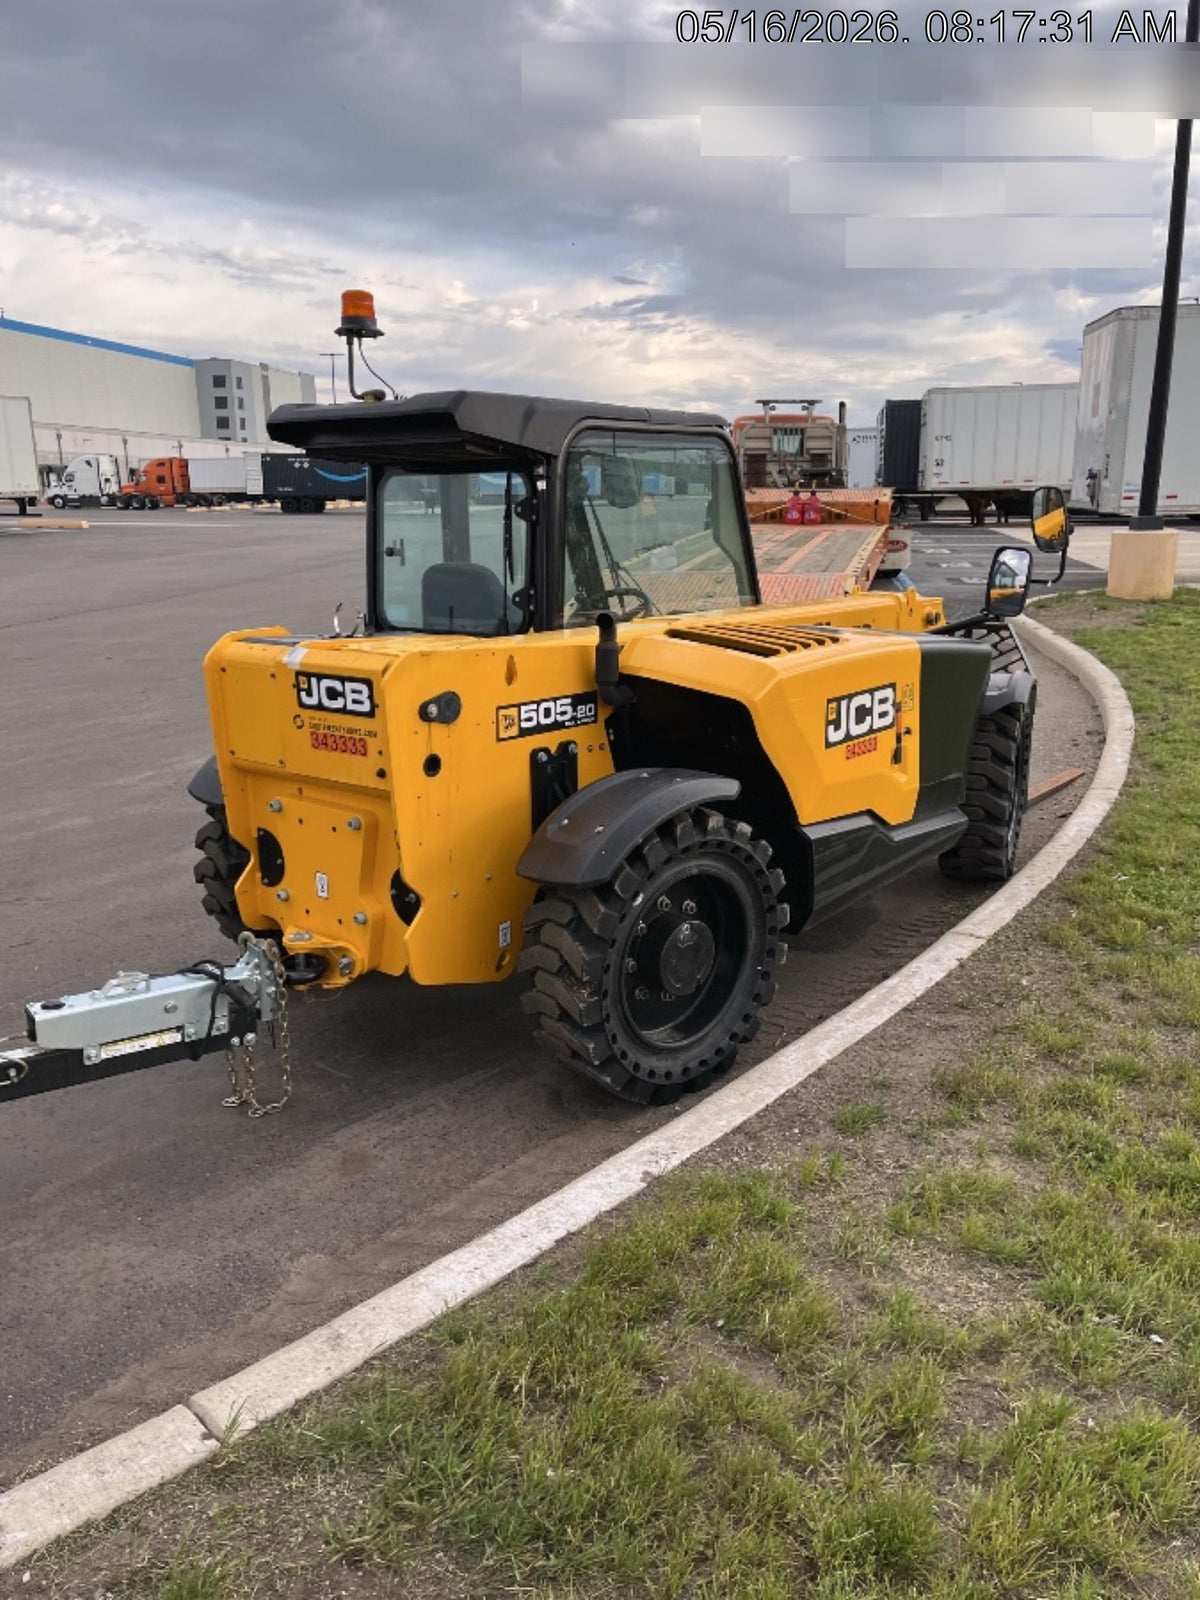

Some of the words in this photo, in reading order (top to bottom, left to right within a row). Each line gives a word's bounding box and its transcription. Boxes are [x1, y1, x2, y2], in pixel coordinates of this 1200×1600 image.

[300, 676, 371, 712] JCB
[827, 687, 895, 744] JCB
[310, 731, 368, 757] 343333
